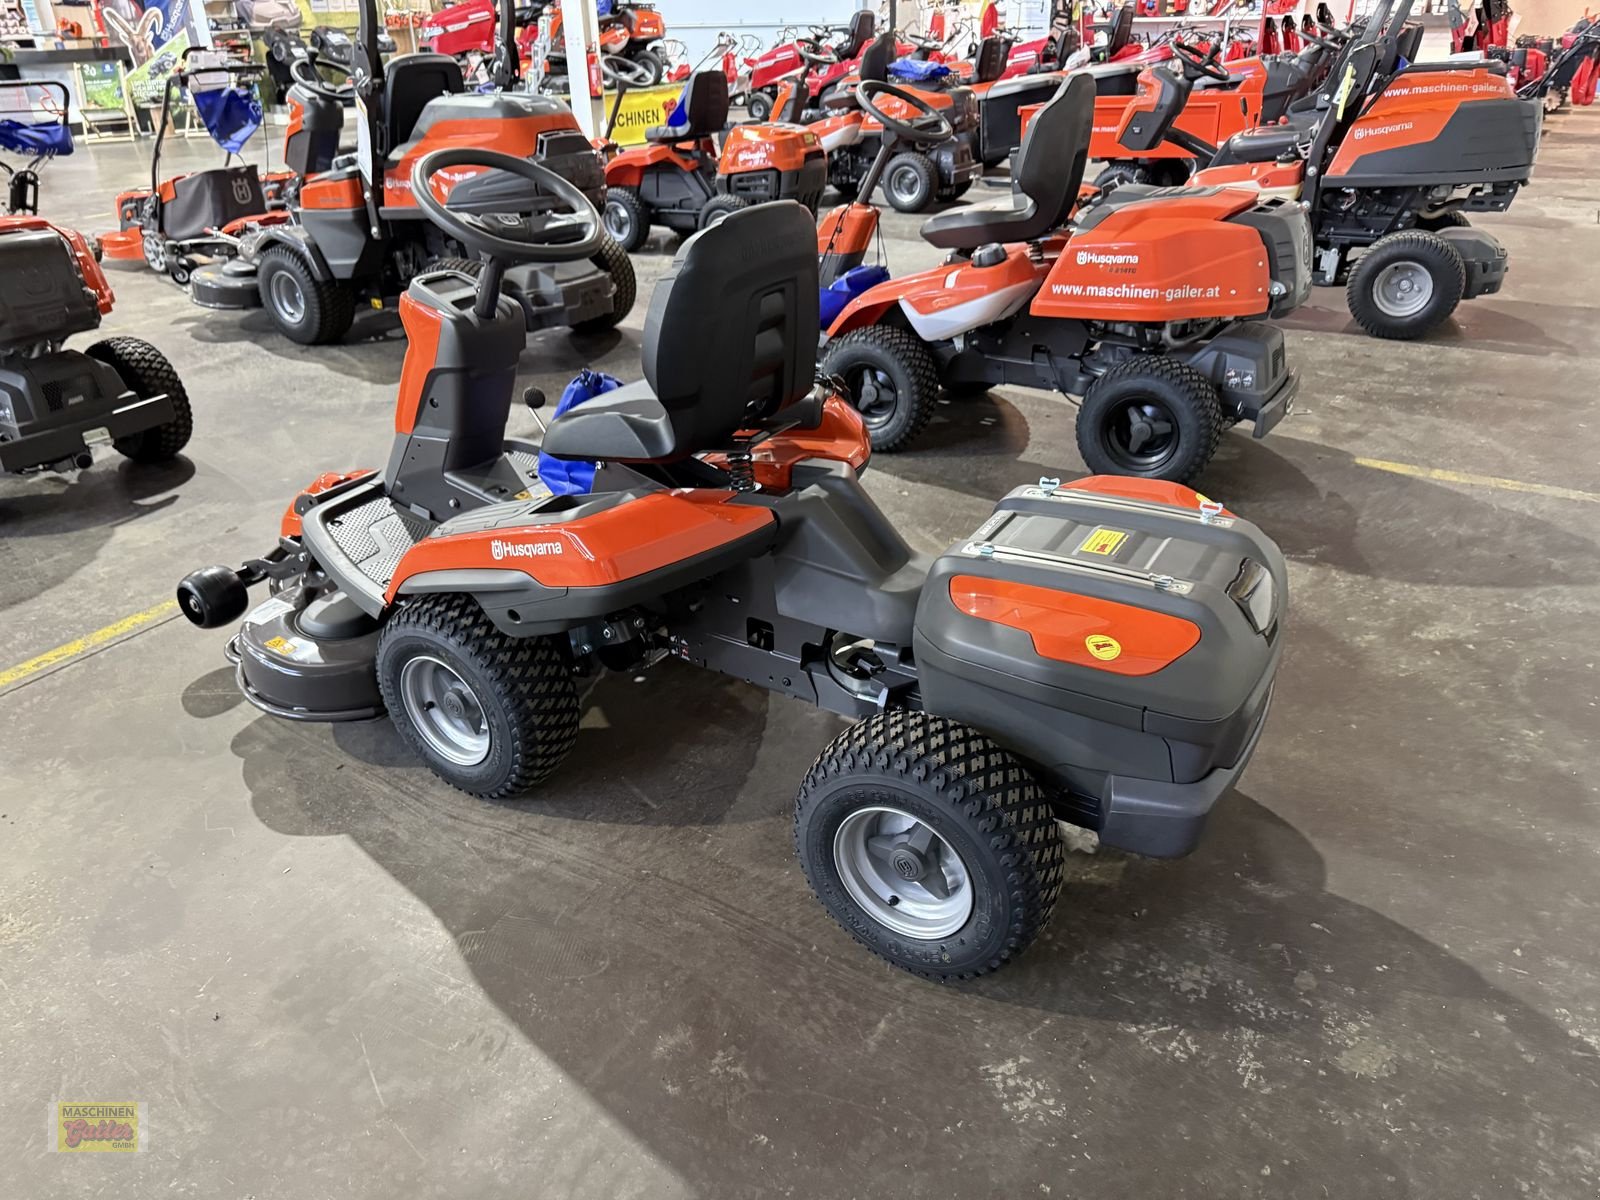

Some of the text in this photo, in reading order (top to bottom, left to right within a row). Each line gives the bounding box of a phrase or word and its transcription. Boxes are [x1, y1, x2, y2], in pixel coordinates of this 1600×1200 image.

[1364, 121, 1413, 137] Husqvarna
[1087, 253, 1139, 265] Husqvarna
[1051, 283, 1221, 302] www.maschinen-gailer.at
[503, 541, 563, 558] Husqvarna
